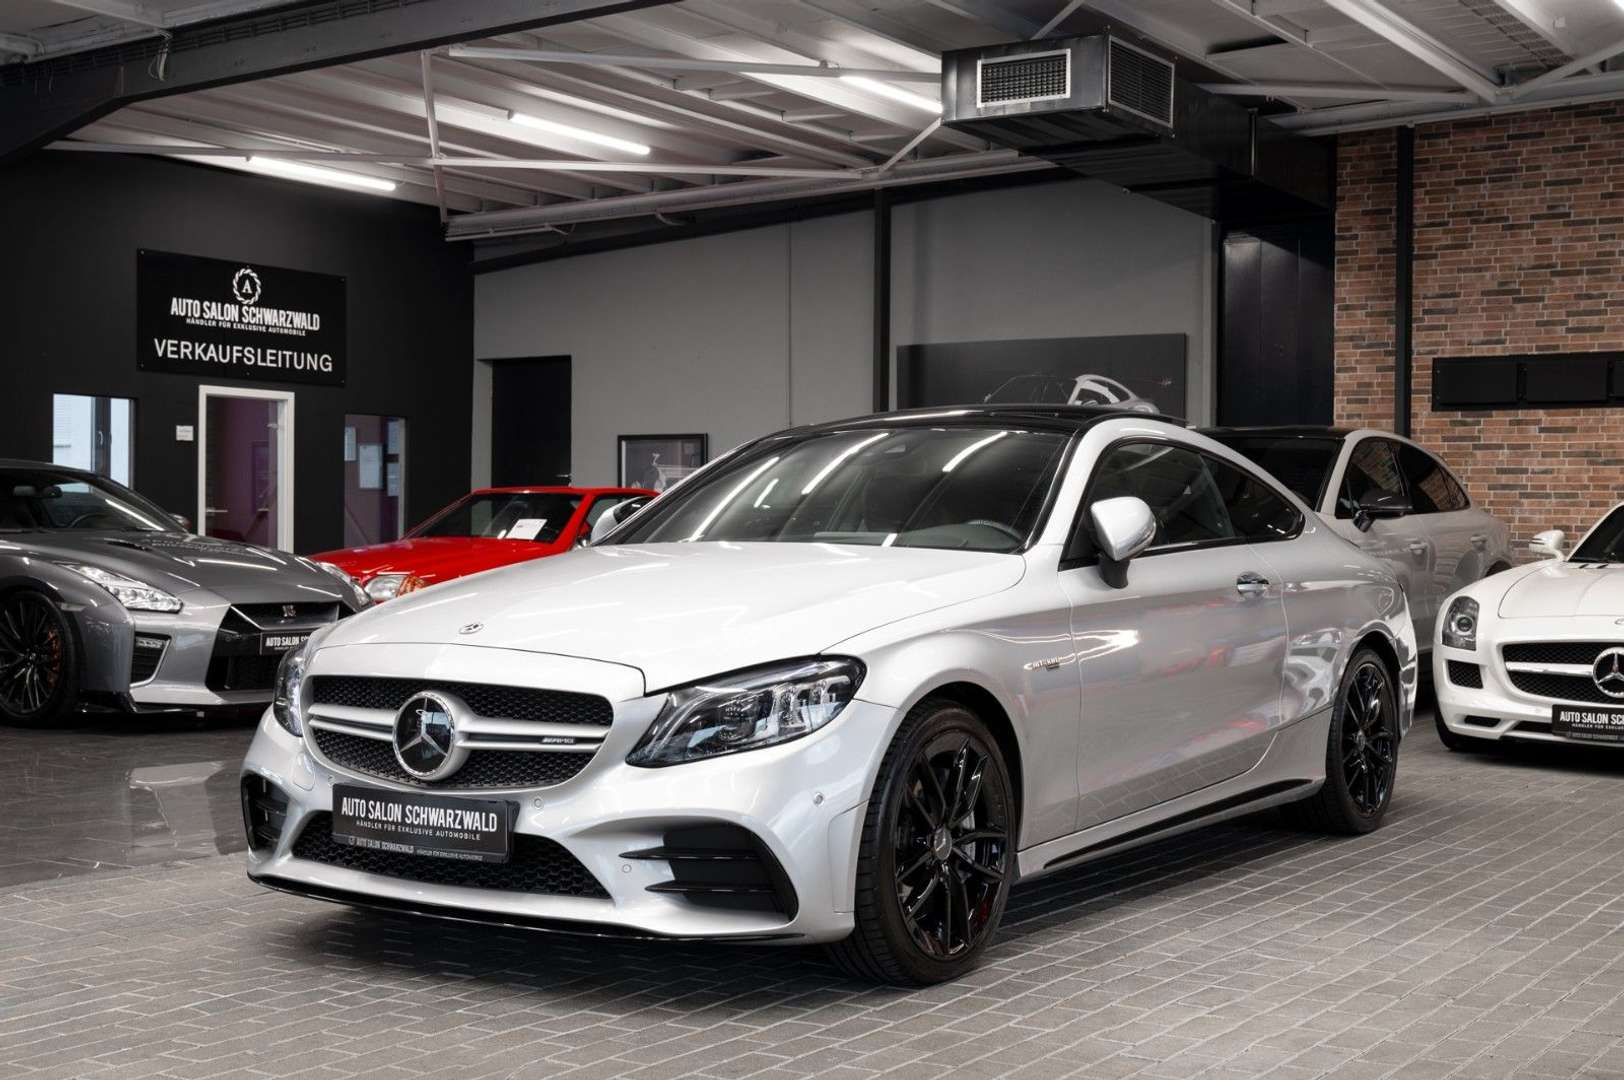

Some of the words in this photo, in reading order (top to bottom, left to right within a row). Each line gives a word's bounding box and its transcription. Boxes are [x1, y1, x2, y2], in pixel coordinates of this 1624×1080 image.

[242, 279, 252, 294] A
[171, 297, 201, 318] AUTO
[203, 301, 239, 322] SALON
[242, 306, 320, 331] SCHWARZWALD
[186, 317, 217, 327] HÄNDLER
[218, 320, 231, 329] FÜR
[233, 322, 266, 333] EXKLUSIVE
[268, 326, 306, 337] AUTOMOBILE
[154, 337, 333, 372] VERKAUFSLEITUNG
[265, 636, 281, 647] AUTO
[281, 636, 300, 646] SALON
[1560, 711, 1580, 722] AUTO
[1582, 712, 1609, 724] SALON
[341, 797, 367, 818] AUTO
[368, 800, 402, 823] SALON
[405, 804, 498, 833] SCHWARZWALD
[356, 820, 382, 830] HÄNDLER
[398, 825, 433, 836] EXKLUSIVE
[436, 830, 481, 841] AUTOMOBILE
